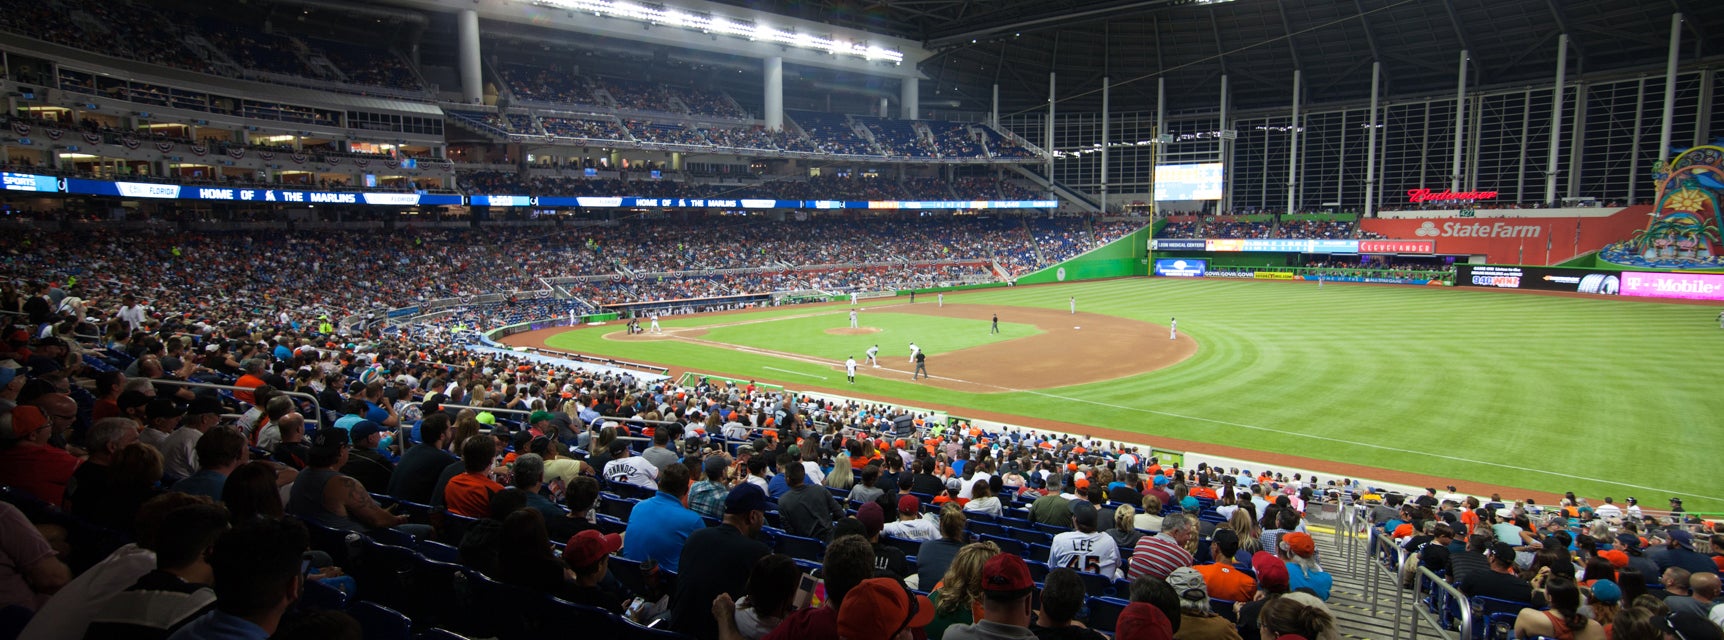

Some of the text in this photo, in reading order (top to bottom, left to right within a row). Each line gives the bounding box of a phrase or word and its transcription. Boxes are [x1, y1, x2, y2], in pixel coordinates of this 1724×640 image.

[3, 177, 36, 187] SPORTS
[149, 186, 175, 196] FLORIDA
[200, 188, 355, 203] HOME OF THE MARLINS
[1407, 188, 1498, 203] Budweiser
[690, 199, 704, 207] THE
[1360, 241, 1430, 252] CLEVELANDER
[1072, 539, 1095, 553] LEE
[1065, 554, 1101, 575] 45
